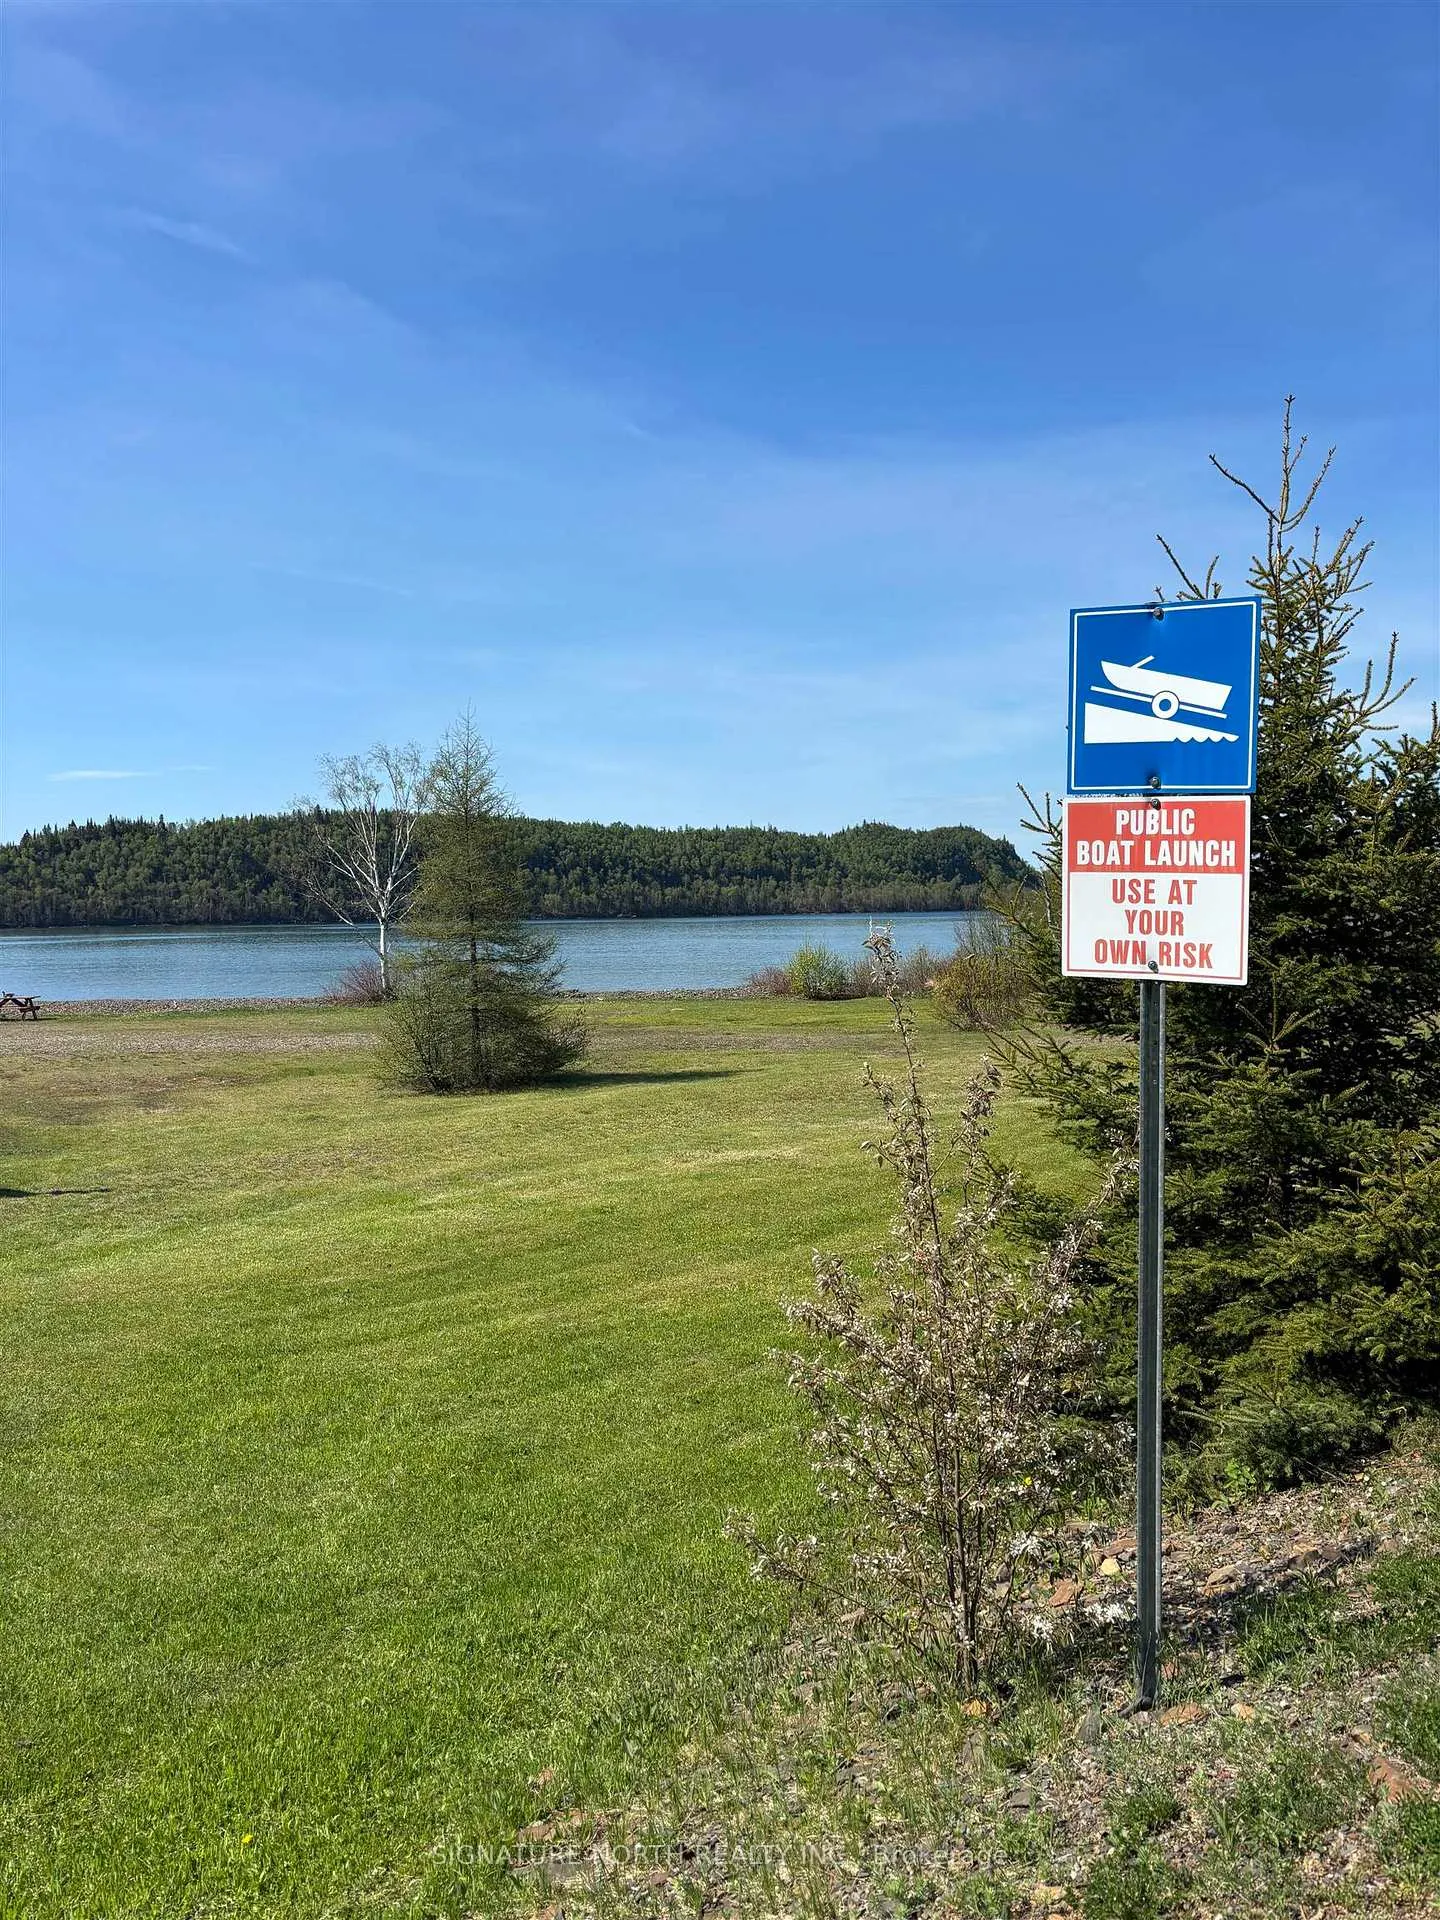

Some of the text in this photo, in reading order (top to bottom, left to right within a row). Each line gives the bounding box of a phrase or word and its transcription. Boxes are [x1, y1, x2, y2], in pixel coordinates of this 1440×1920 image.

[1115, 808, 1196, 836] PUBLIC
[1076, 839, 1236, 867] BOAT LAUNCH
[1112, 878, 1198, 905] USE AT
[1124, 909, 1185, 936] YOUR
[1094, 938, 1213, 969] OWN RISK
